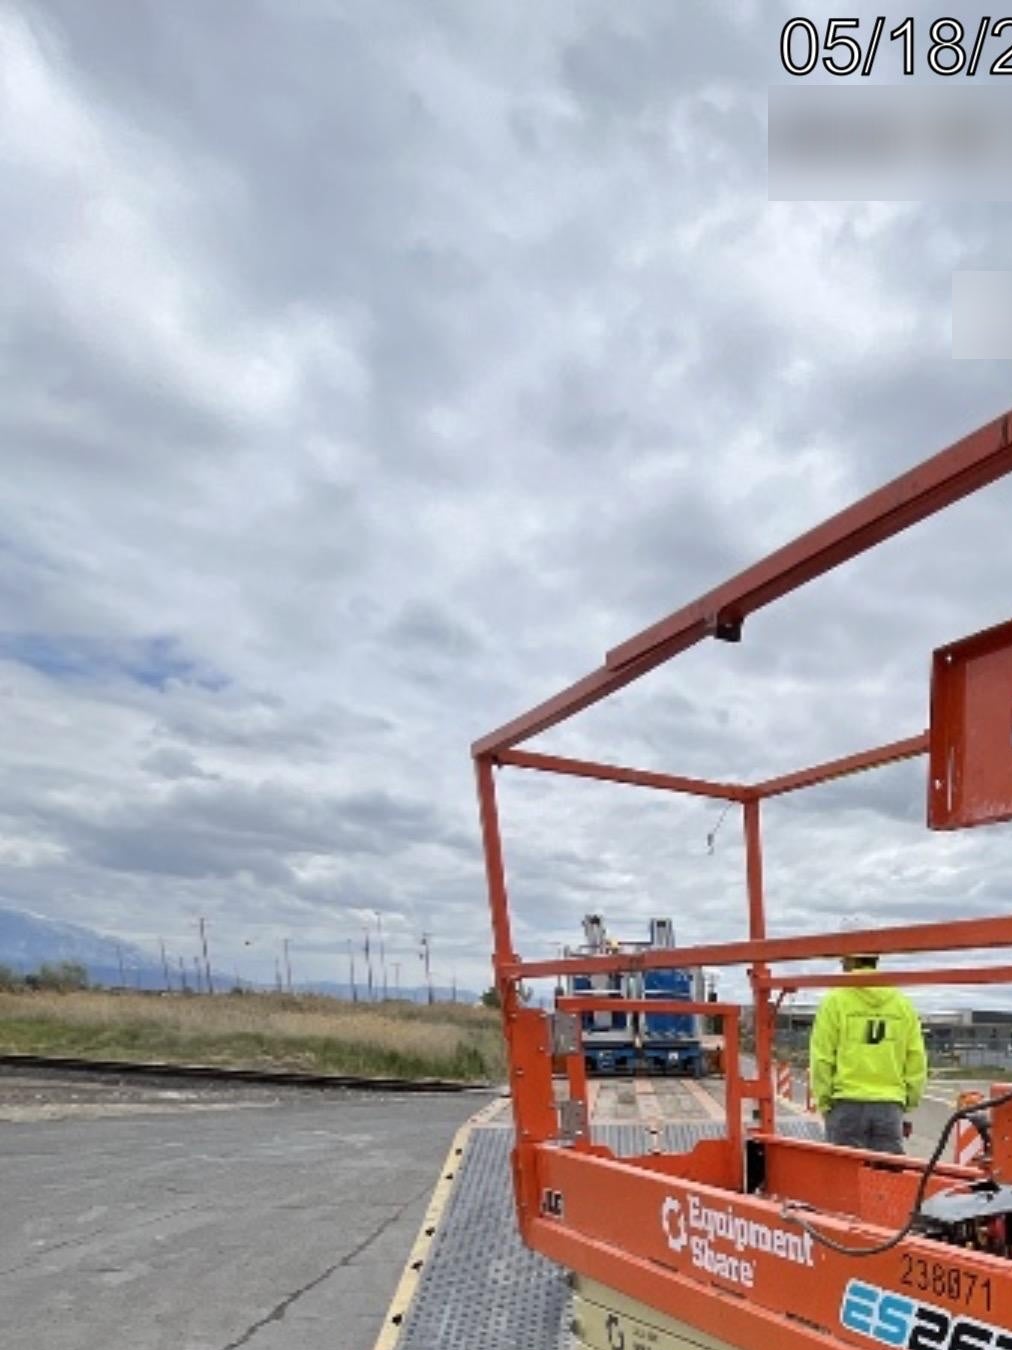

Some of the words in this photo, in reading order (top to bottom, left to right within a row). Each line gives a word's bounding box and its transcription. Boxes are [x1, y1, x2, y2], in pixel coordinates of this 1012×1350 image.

[687, 1195, 814, 1266] Equipment
[690, 1236, 754, 1287] Share
[901, 1253, 993, 1312] 238071
